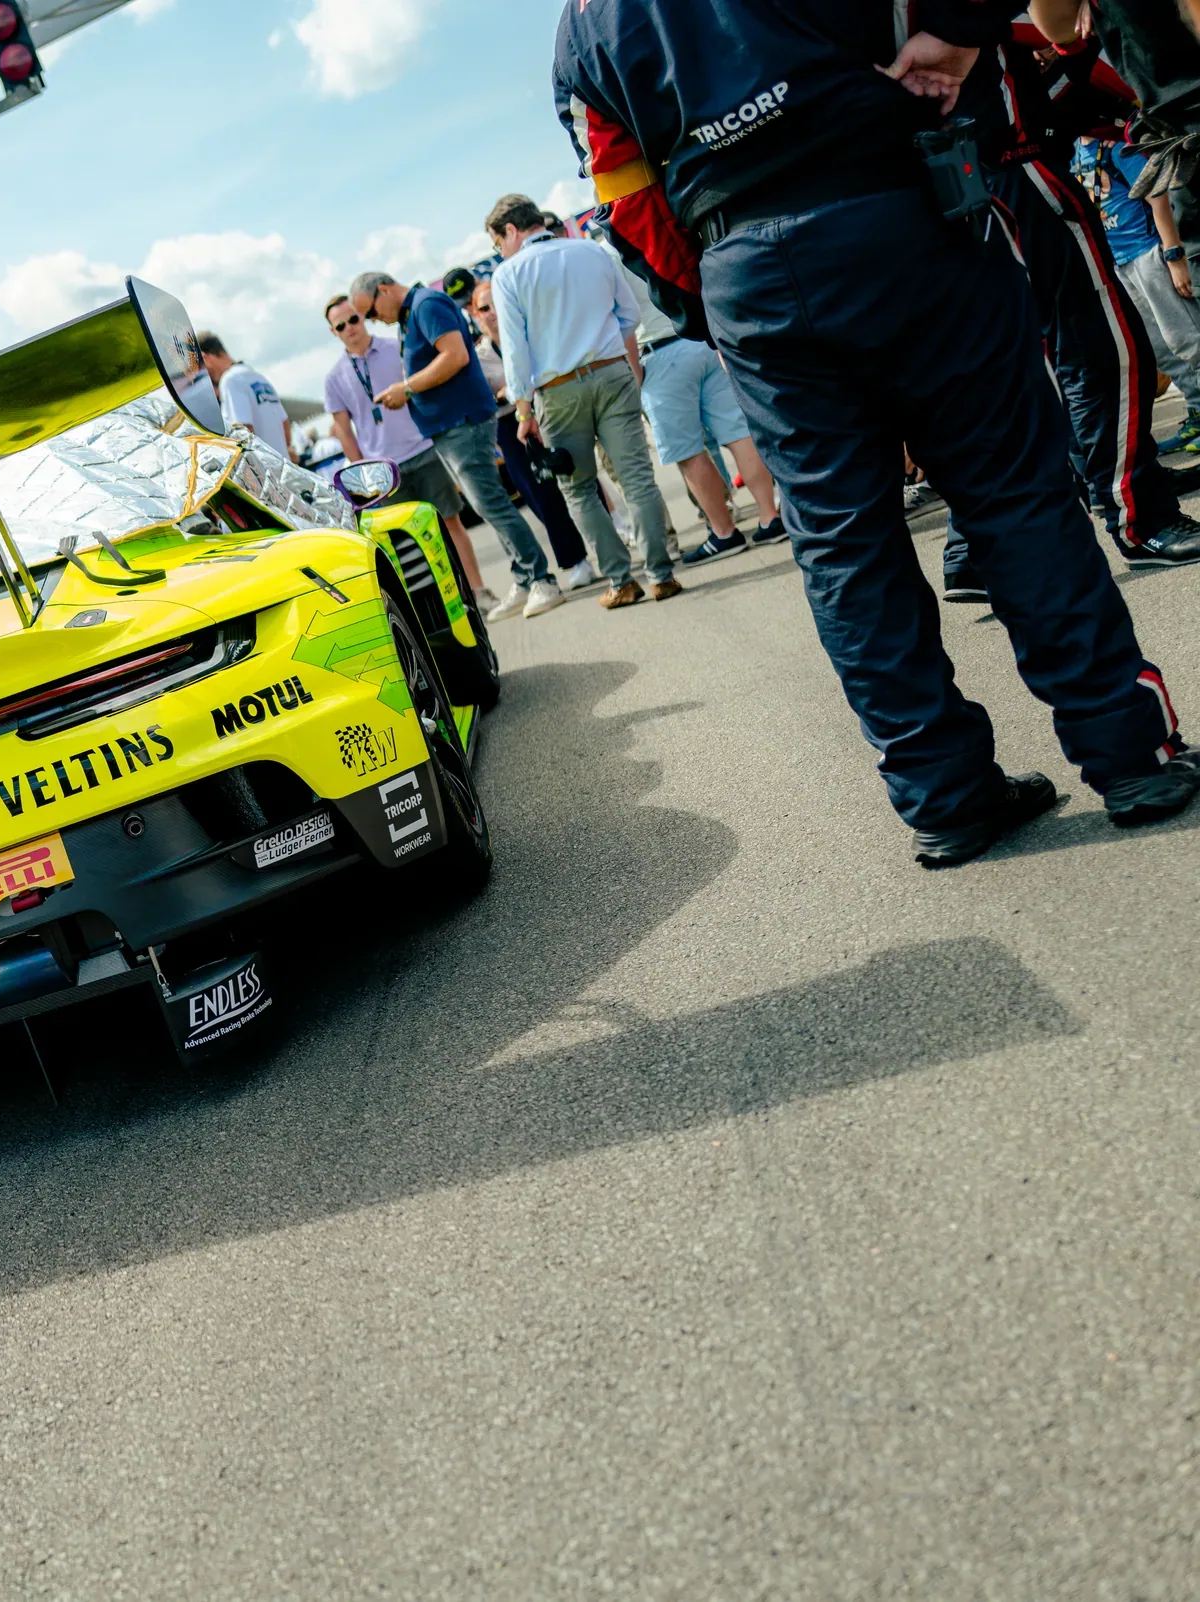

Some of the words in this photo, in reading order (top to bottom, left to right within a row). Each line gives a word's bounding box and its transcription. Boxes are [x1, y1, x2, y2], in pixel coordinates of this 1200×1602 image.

[689, 81, 789, 143] TRICORP
[709, 109, 784, 151] WORKWEAR
[210, 675, 314, 740] MOTUL
[351, 727, 398, 777] KW
[384, 793, 423, 820] TRICORP
[269, 838, 302, 860] Ludger
[304, 825, 333, 847] Ferner
[393, 832, 432, 858] WORKWEAR
[189, 963, 261, 1028] ENDLESS
[184, 1029, 220, 1049] Advanced
[220, 1020, 242, 1035] Racing
[240, 1012, 255, 1024] Brake
